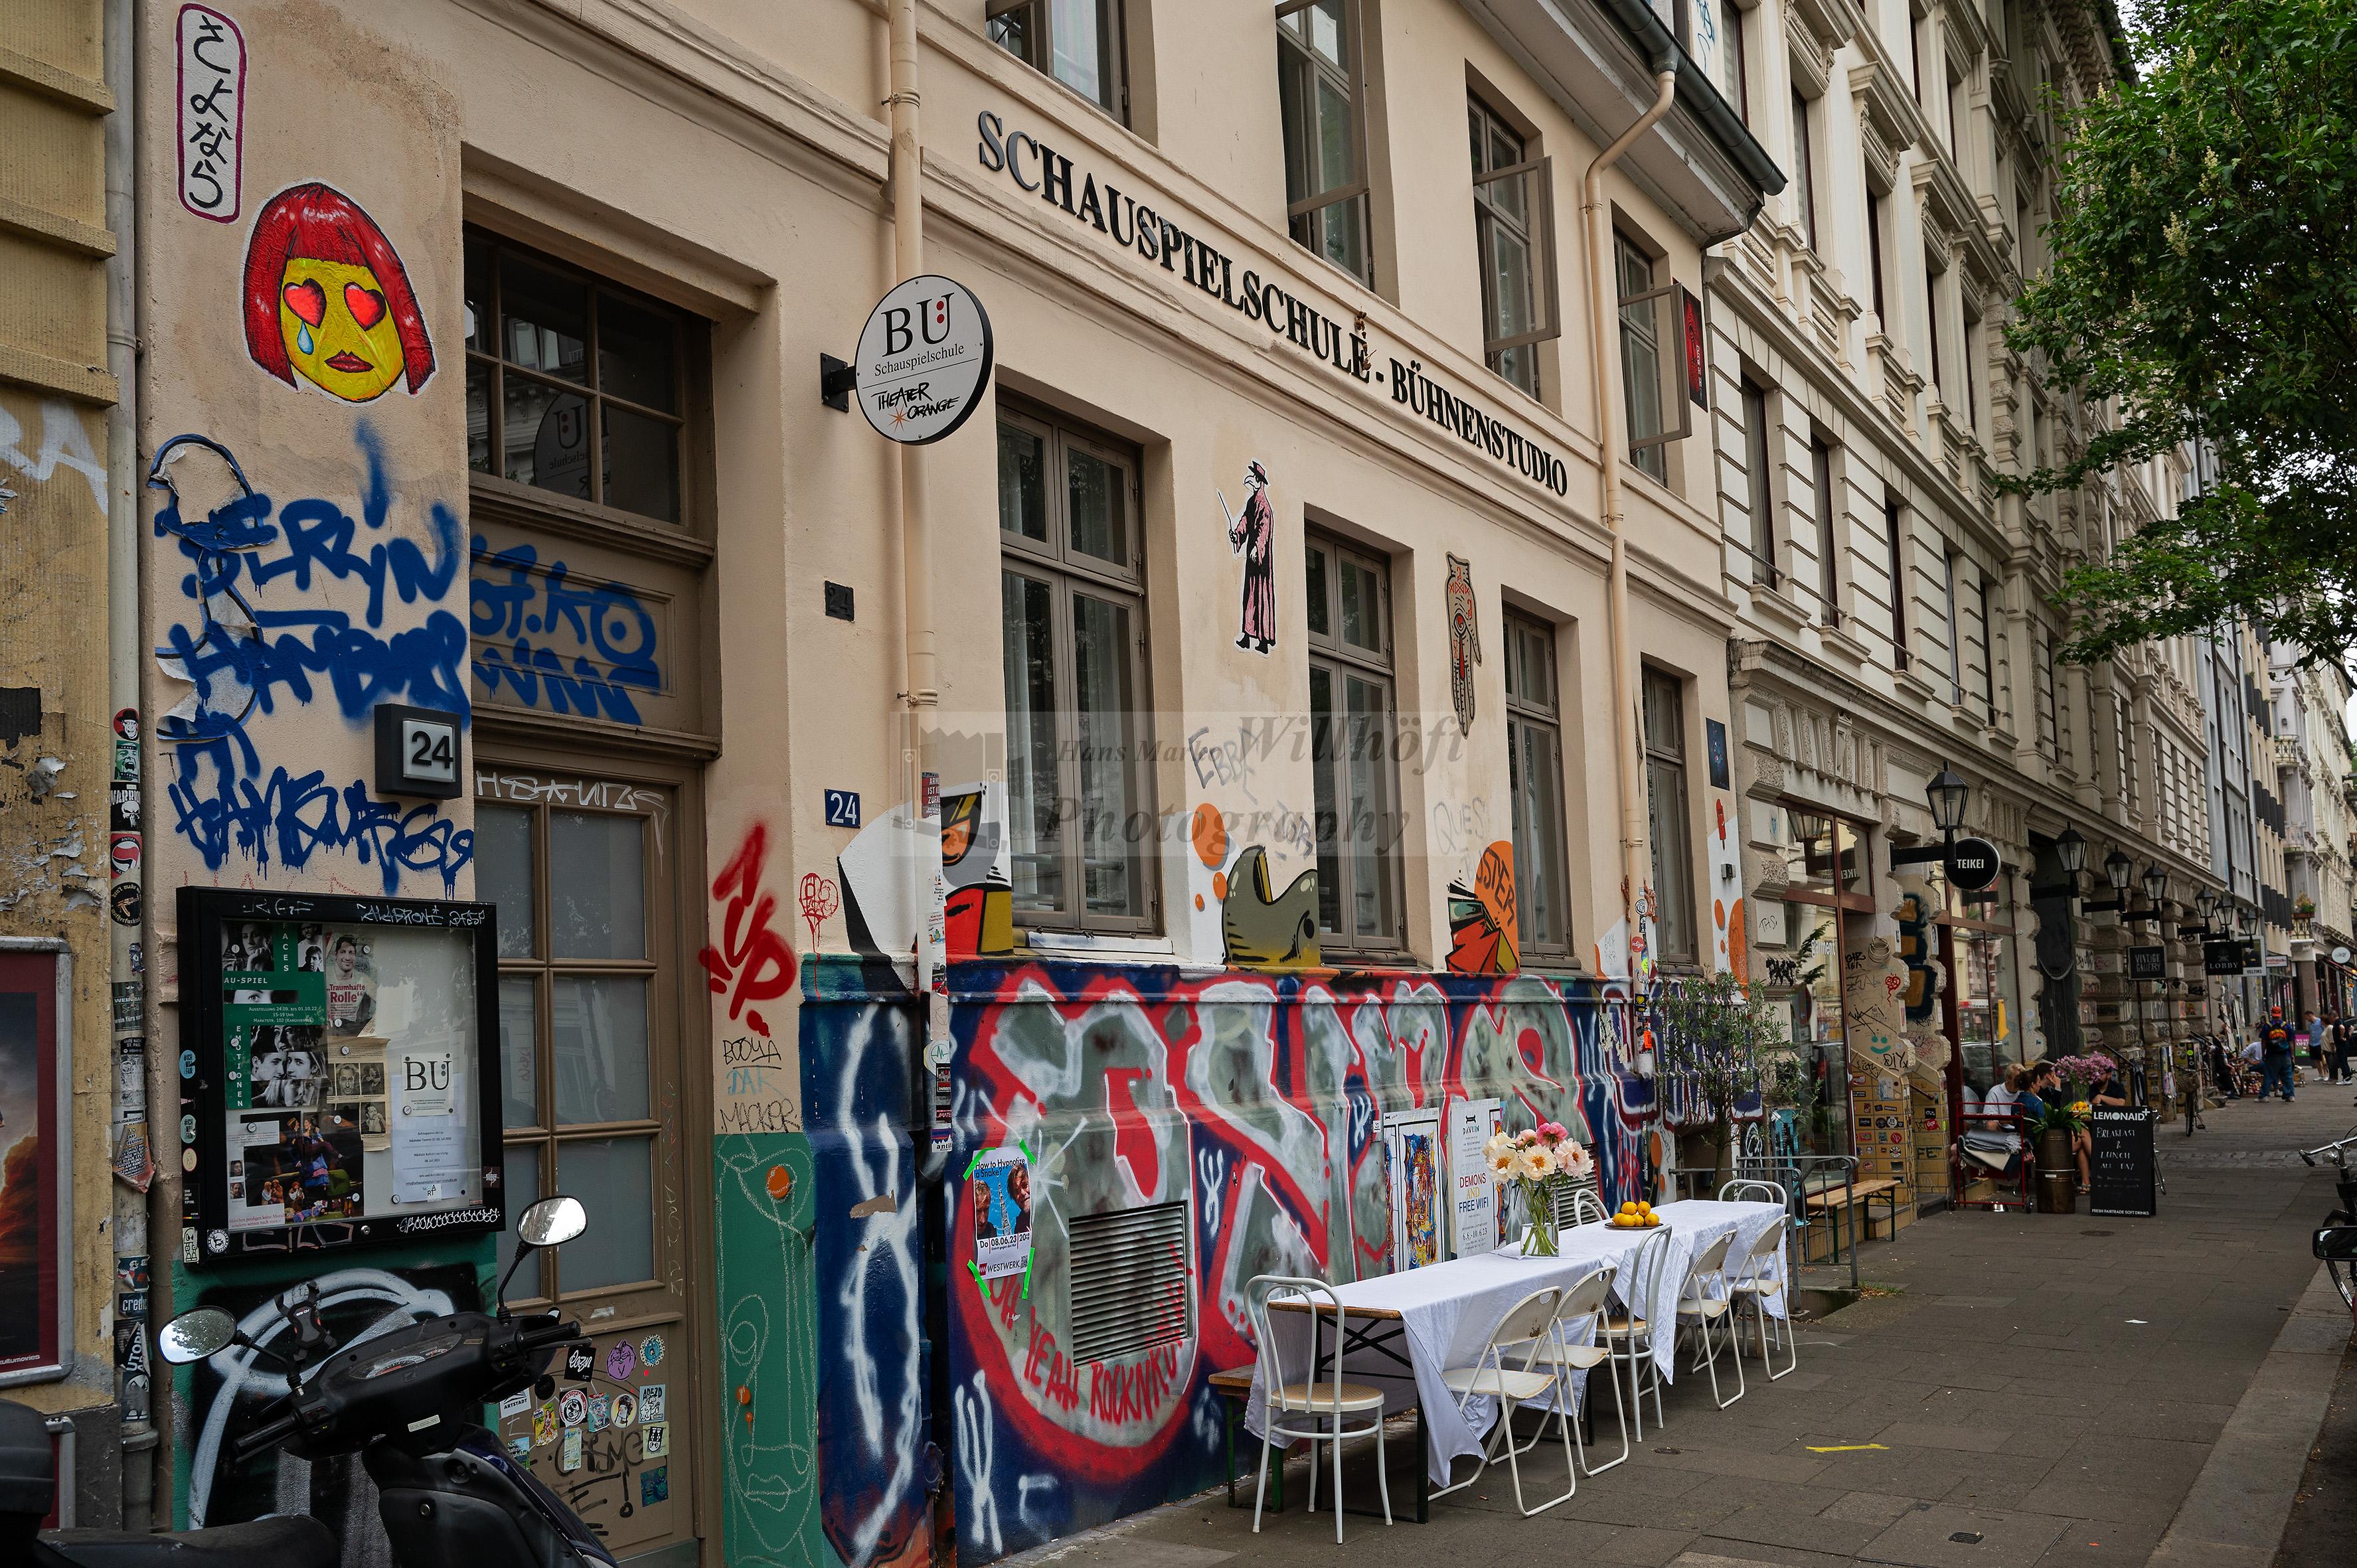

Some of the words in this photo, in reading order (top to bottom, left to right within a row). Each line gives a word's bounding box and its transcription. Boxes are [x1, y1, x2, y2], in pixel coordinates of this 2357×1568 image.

[189, 15, 232, 208] さよなら
[978, 110, 1370, 383] SCHAUSPIELSCHULE
[1390, 357, 1568, 497] BÜHNENSTUDIO
[881, 293, 955, 357] BÜ
[874, 345, 964, 377] Schauspielschule
[871, 382, 932, 410] THEATER
[906, 397, 960, 420] ORANGE
[411, 731, 453, 769] 24
[831, 793, 857, 825] 24
[1957, 859, 1984, 869] TEIKEI
[1811, 938, 1836, 957] garment
[975, 1161, 989, 1170] How
[997, 1157, 1025, 1170] Hypnotize
[981, 1167, 1003, 1178] Snake?
[1459, 1172, 1487, 1188] DEMONS
[1466, 1186, 1480, 1200] AND
[1459, 1200, 1475, 1214] FREE
[1476, 1196, 1489, 1210] WIFI
[979, 1240, 988, 1249] Do
[991, 1236, 1017, 1247] 08.06.23
[987, 1260, 1021, 1273] WESTWERK
[504, 1399, 528, 1409] ARTSTADT
